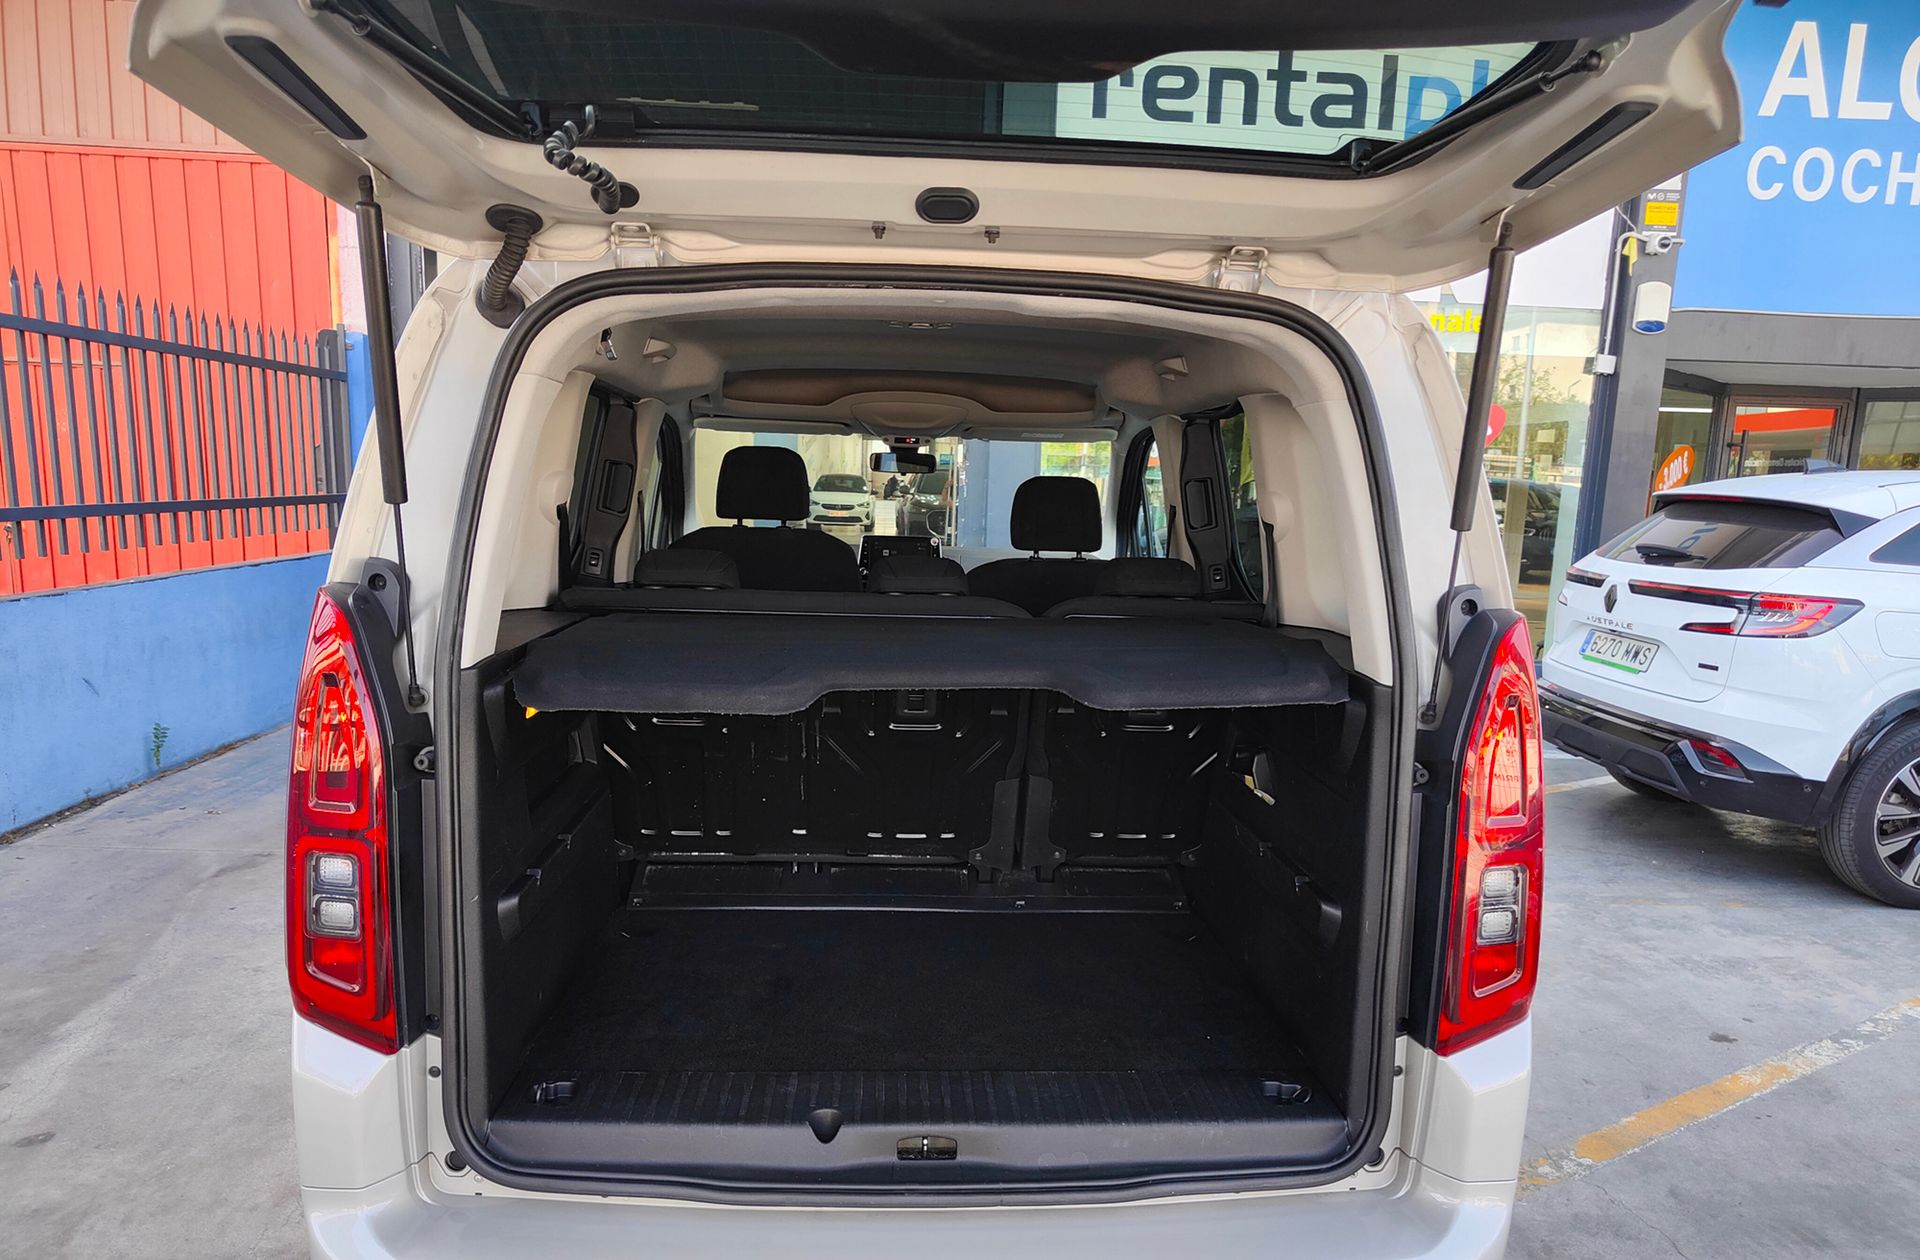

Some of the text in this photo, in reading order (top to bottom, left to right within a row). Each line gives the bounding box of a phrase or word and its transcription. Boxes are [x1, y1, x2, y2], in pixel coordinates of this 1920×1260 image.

[1746, 145, 1920, 207] COCH
[1590, 635, 1652, 666] 6270 MWS
